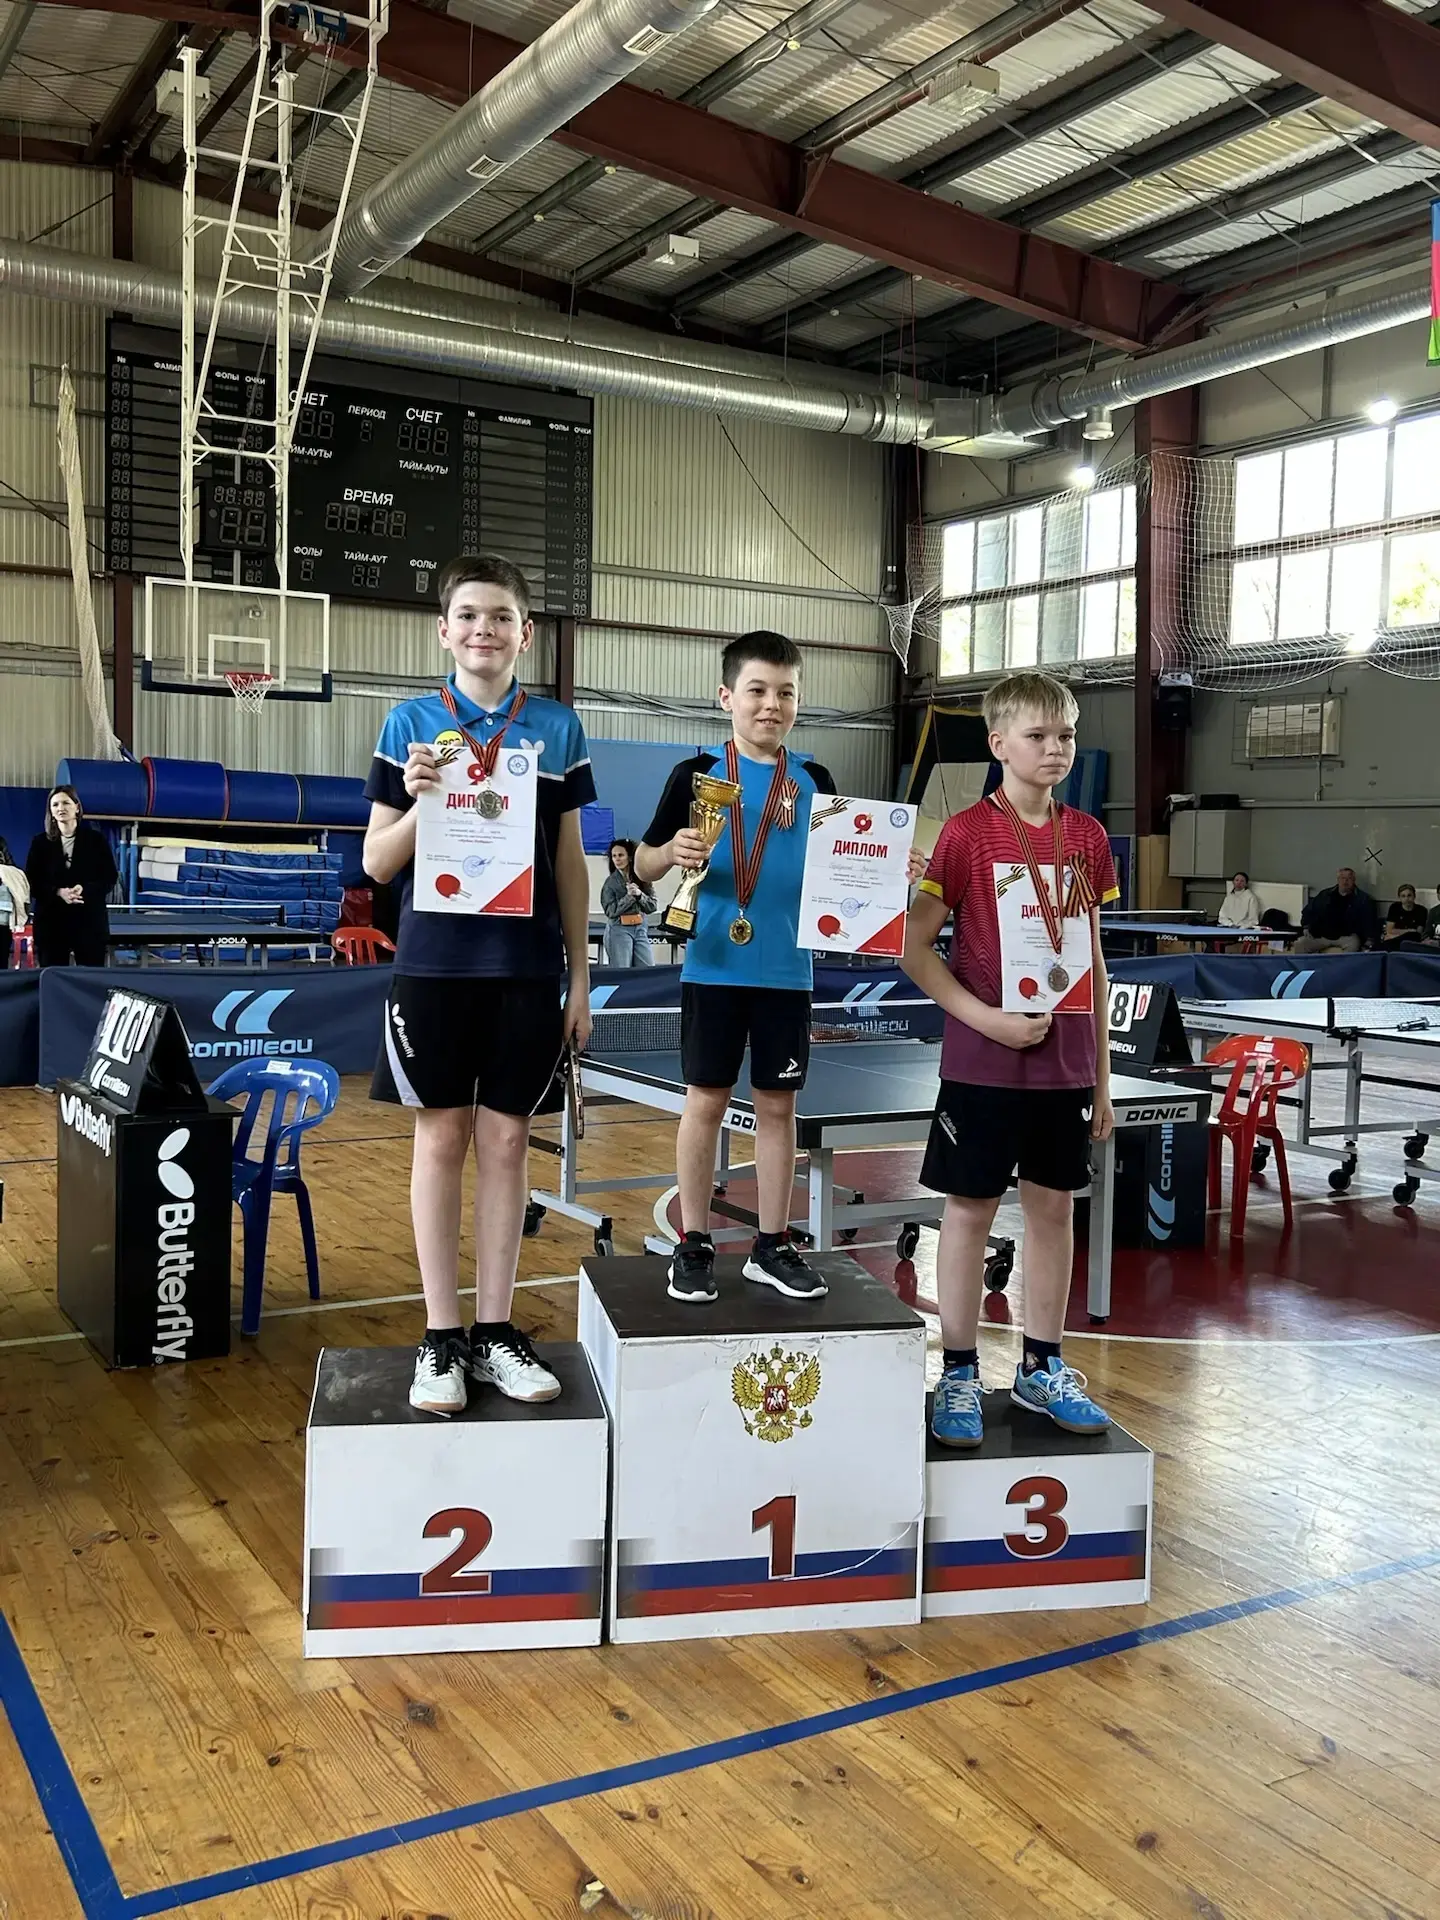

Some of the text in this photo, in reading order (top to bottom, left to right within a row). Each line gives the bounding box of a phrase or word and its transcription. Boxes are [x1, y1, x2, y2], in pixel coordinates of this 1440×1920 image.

[153, 361, 183, 372] ФАМИЛ
[215, 371, 240, 381] ФОЛЫ
[245, 375, 266, 385] ОЧКИ
[347, 404, 387, 420] ПЕРИОД
[405, 407, 444, 424] СЧЕТ
[498, 415, 532, 426] ФАМИЛИЯ
[548, 423, 570, 432] ФОЛЫ
[573, 426, 592, 435] ОЧКИ
[291, 444, 333, 459] ЙМ-АУТЫ
[399, 459, 449, 475] ТАЙМ-АУТЫ
[343, 488, 394, 506] ВРЕМЯ
[293, 545, 323, 557] ФОЛЫ
[343, 550, 388, 564] ТАЙМ-АУТ
[409, 558, 437, 569] ФОЛЫ
[832, 839, 888, 859] ДИПЛОМ
[216, 937, 248, 945] JOOLA
[1110, 991, 1130, 1027] 8
[1125, 1106, 1189, 1122] DONIC
[151, 1201, 196, 1360] Butterfly
[1002, 1474, 1069, 1560] 3
[751, 1494, 797, 1580] 1
[419, 1505, 494, 1596] 2
